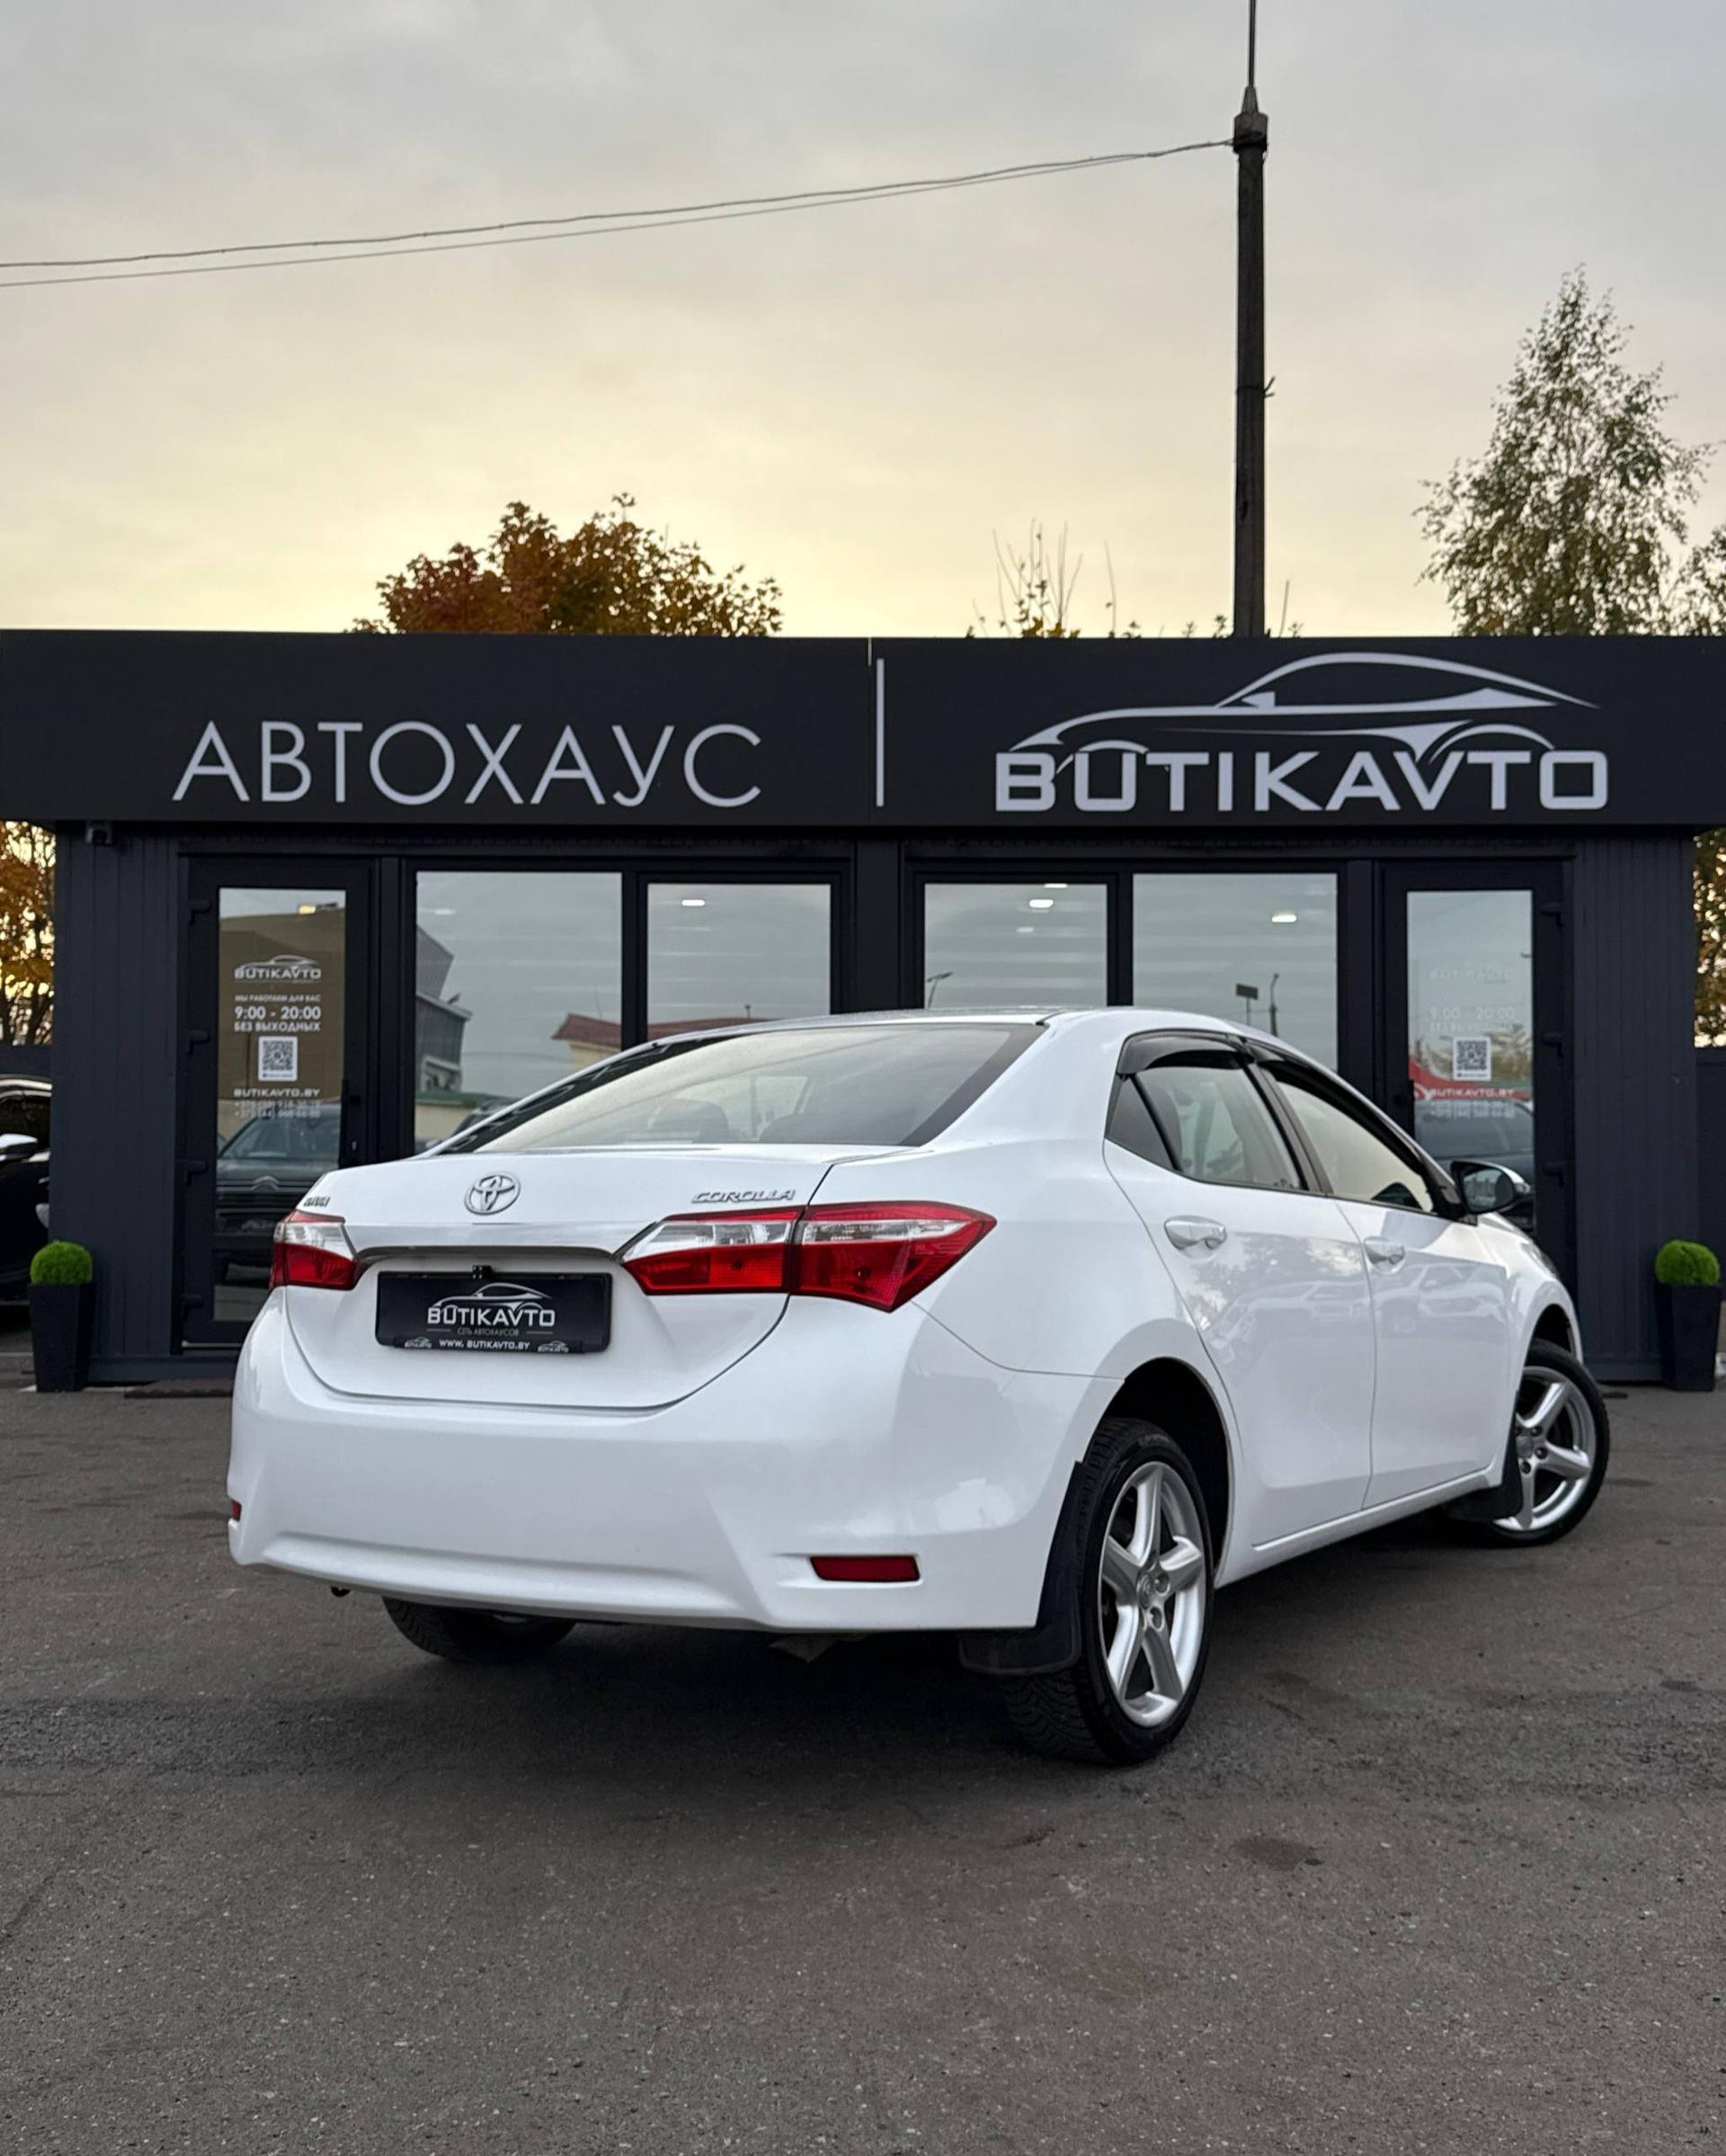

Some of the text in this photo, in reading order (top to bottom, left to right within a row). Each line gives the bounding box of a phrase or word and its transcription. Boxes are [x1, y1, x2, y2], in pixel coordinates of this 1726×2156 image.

[172, 719, 762, 809] АВТОХАУС
[994, 749, 1608, 813] BUTIKAVTO
[234, 967, 322, 979] BUTIKAVTO
[234, 1005, 267, 1020] 9:00
[280, 1005, 322, 1020] 20:00
[234, 1020, 322, 1033] БЕЗ ВЫХОДНЫХ
[233, 1088, 321, 1098] BUTIKAVTO.BY
[691, 1189, 796, 1204] COROLLA
[427, 1306, 556, 1327] BUTIKAVTO
[467, 1341, 530, 1350] BUTIKAVTO.BY
